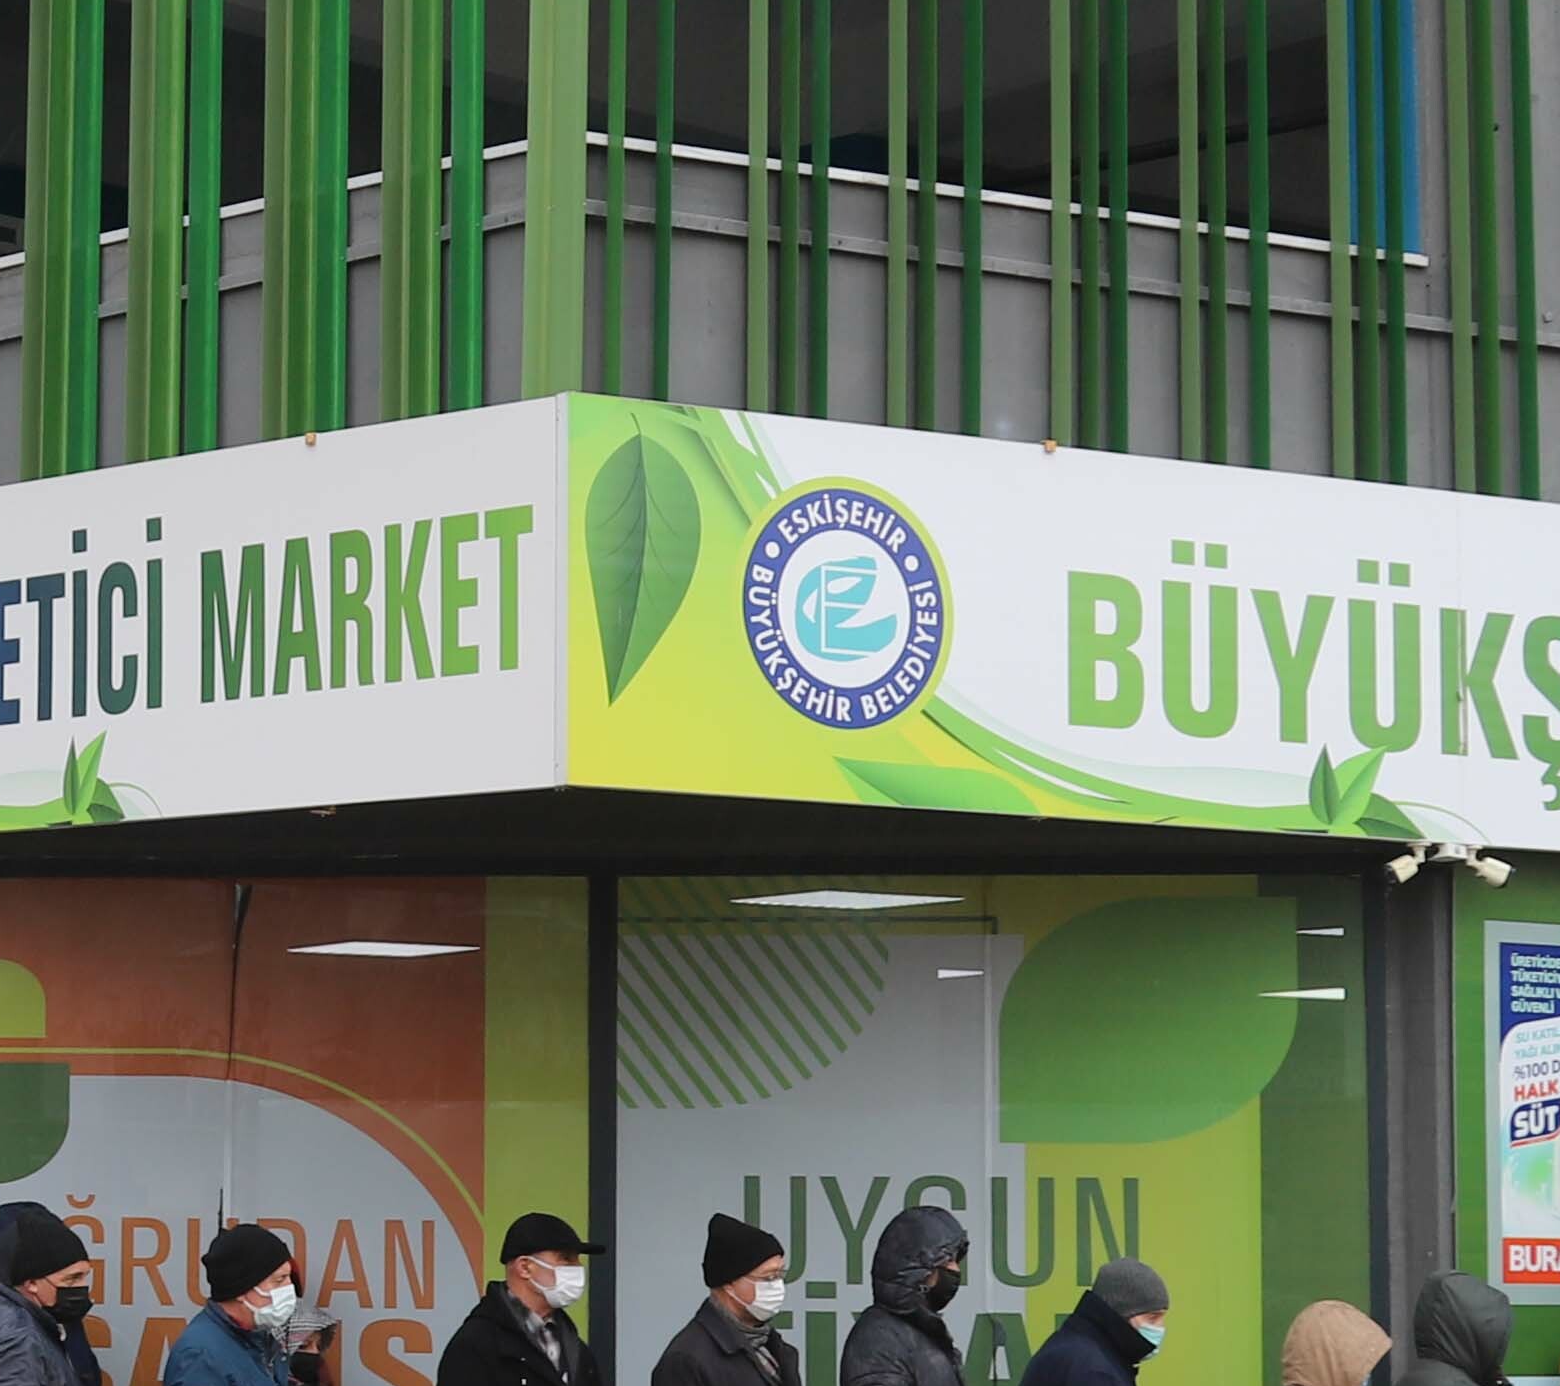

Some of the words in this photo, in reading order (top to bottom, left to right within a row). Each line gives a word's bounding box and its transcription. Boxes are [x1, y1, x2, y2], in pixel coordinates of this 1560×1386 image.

[778, 494, 907, 554] ESKİŞEHİR
[200, 504, 534, 704] MARKET
[749, 563, 852, 722] BÜYÜKŞEHİR
[859, 580, 938, 720] BELEDİYESİ
[1513, 1062, 1549, 1080] %100
[1514, 1079, 1560, 1102] HALK
[1514, 1102, 1560, 1138] SÜT
